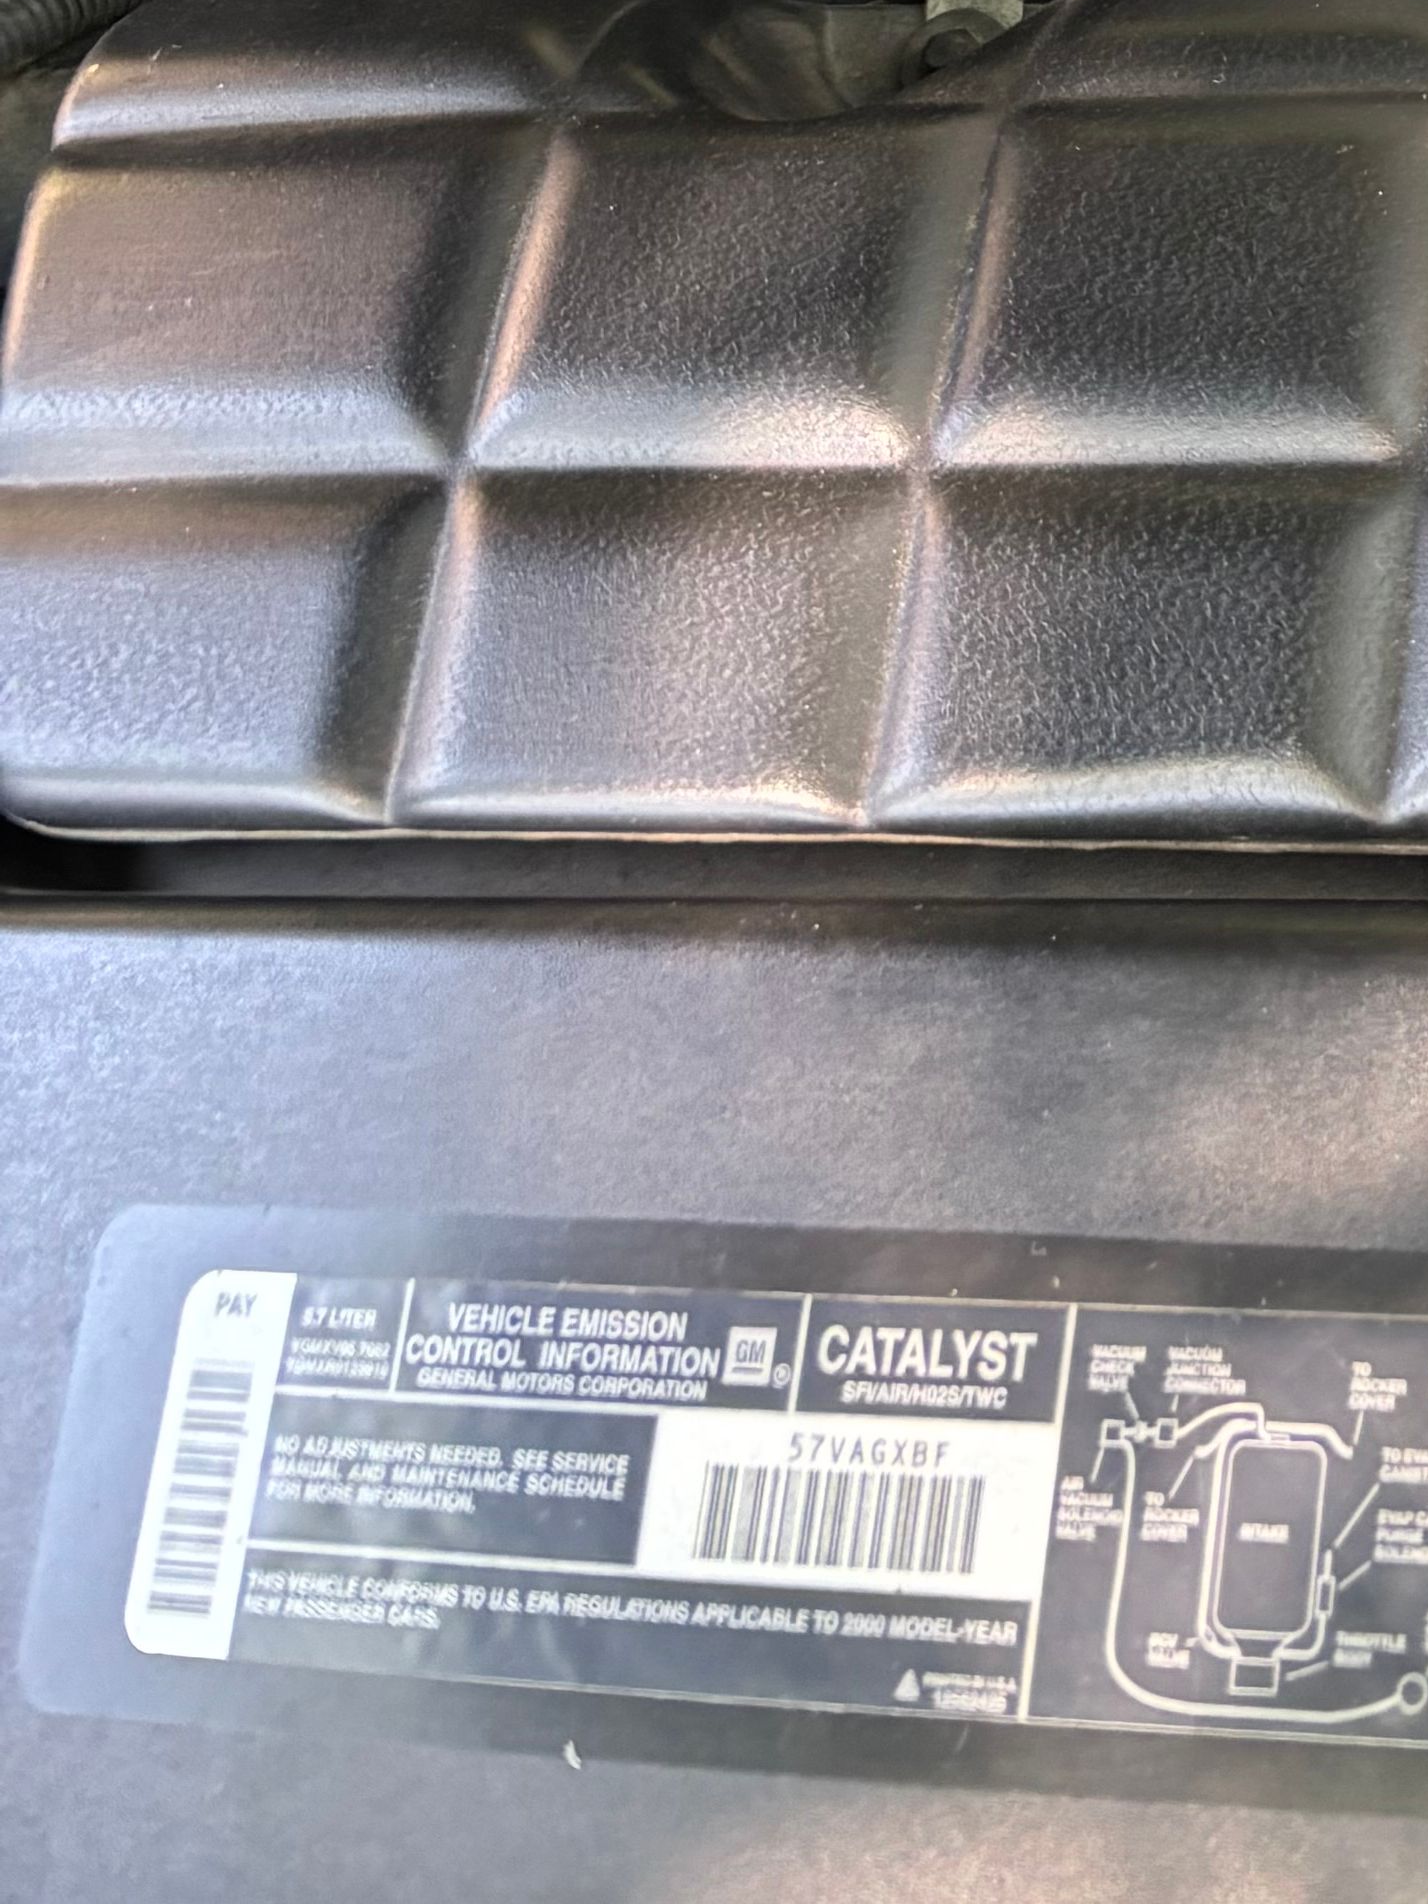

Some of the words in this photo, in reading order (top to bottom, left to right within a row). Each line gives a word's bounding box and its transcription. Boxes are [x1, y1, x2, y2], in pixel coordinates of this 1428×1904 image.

[214, 1292, 257, 1317] PAY
[328, 1307, 377, 1330] LITER
[448, 1303, 554, 1336] VEHICLE
[563, 1306, 688, 1343] EMISSION
[406, 1334, 525, 1370] CONTROL
[540, 1339, 721, 1378] INFORMATION
[735, 1338, 766, 1365] GM
[817, 1324, 1039, 1383] CATALYST
[416, 1366, 498, 1392] GENERAL
[501, 1370, 575, 1395] MOTORS
[578, 1374, 708, 1401] CORPORATION
[274, 1434, 300, 1453] NO
[304, 1436, 427, 1464] ADJUSTMENTS
[430, 1445, 504, 1471] NEEDED.
[512, 1448, 549, 1472] SEE
[552, 1450, 630, 1477] SERVICE
[787, 1432, 950, 1468] 57VAGXBF
[267, 1481, 301, 1502] FOR
[304, 1483, 354, 1507] MORE
[350, 1462, 389, 1484] AND
[392, 1465, 520, 1496] MAINTENANCE
[524, 1471, 627, 1502] SCHEDULE
[287, 1571, 358, 1598] VEHICLE
[361, 1577, 460, 1609] CONFORMS
[463, 1585, 486, 1610] TO
[488, 1586, 523, 1614] U.S.
[526, 1590, 561, 1617] EPA
[562, 1592, 690, 1624] REGULATIONS
[692, 1602, 810, 1634] APPLICABLE
[813, 1609, 839, 1634] TO
[842, 1612, 886, 1639] 2000
[889, 1615, 1019, 1647] MODEL-YEAR
